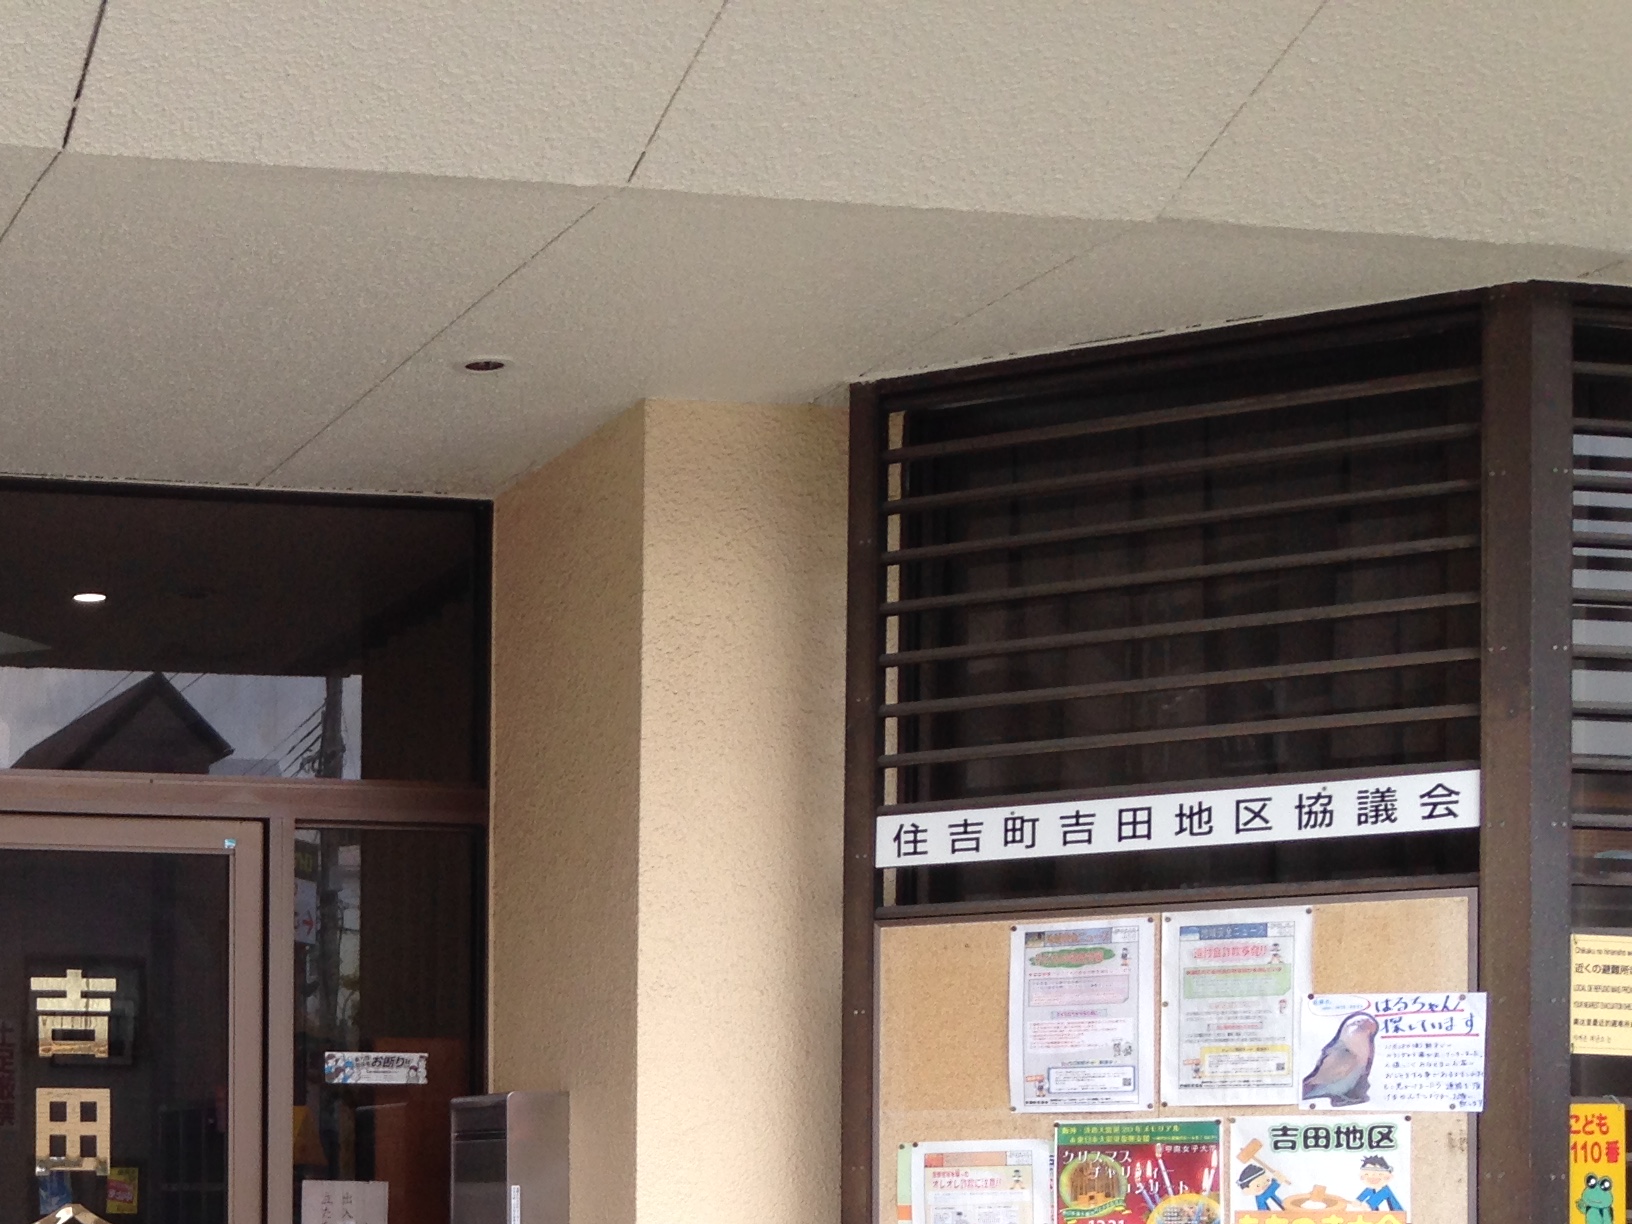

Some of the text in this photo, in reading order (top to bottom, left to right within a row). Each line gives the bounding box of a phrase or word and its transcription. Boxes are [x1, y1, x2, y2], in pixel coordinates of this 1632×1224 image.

[892, 781, 1461, 858] 住吉町吉田地区協議会
[1570, 1113, 1610, 1136] こども
[1270, 1125, 1396, 1151] 吉田地区
[1062, 1149, 1133, 1165] クリスマス
[1571, 1140, 1620, 1164] 110番
